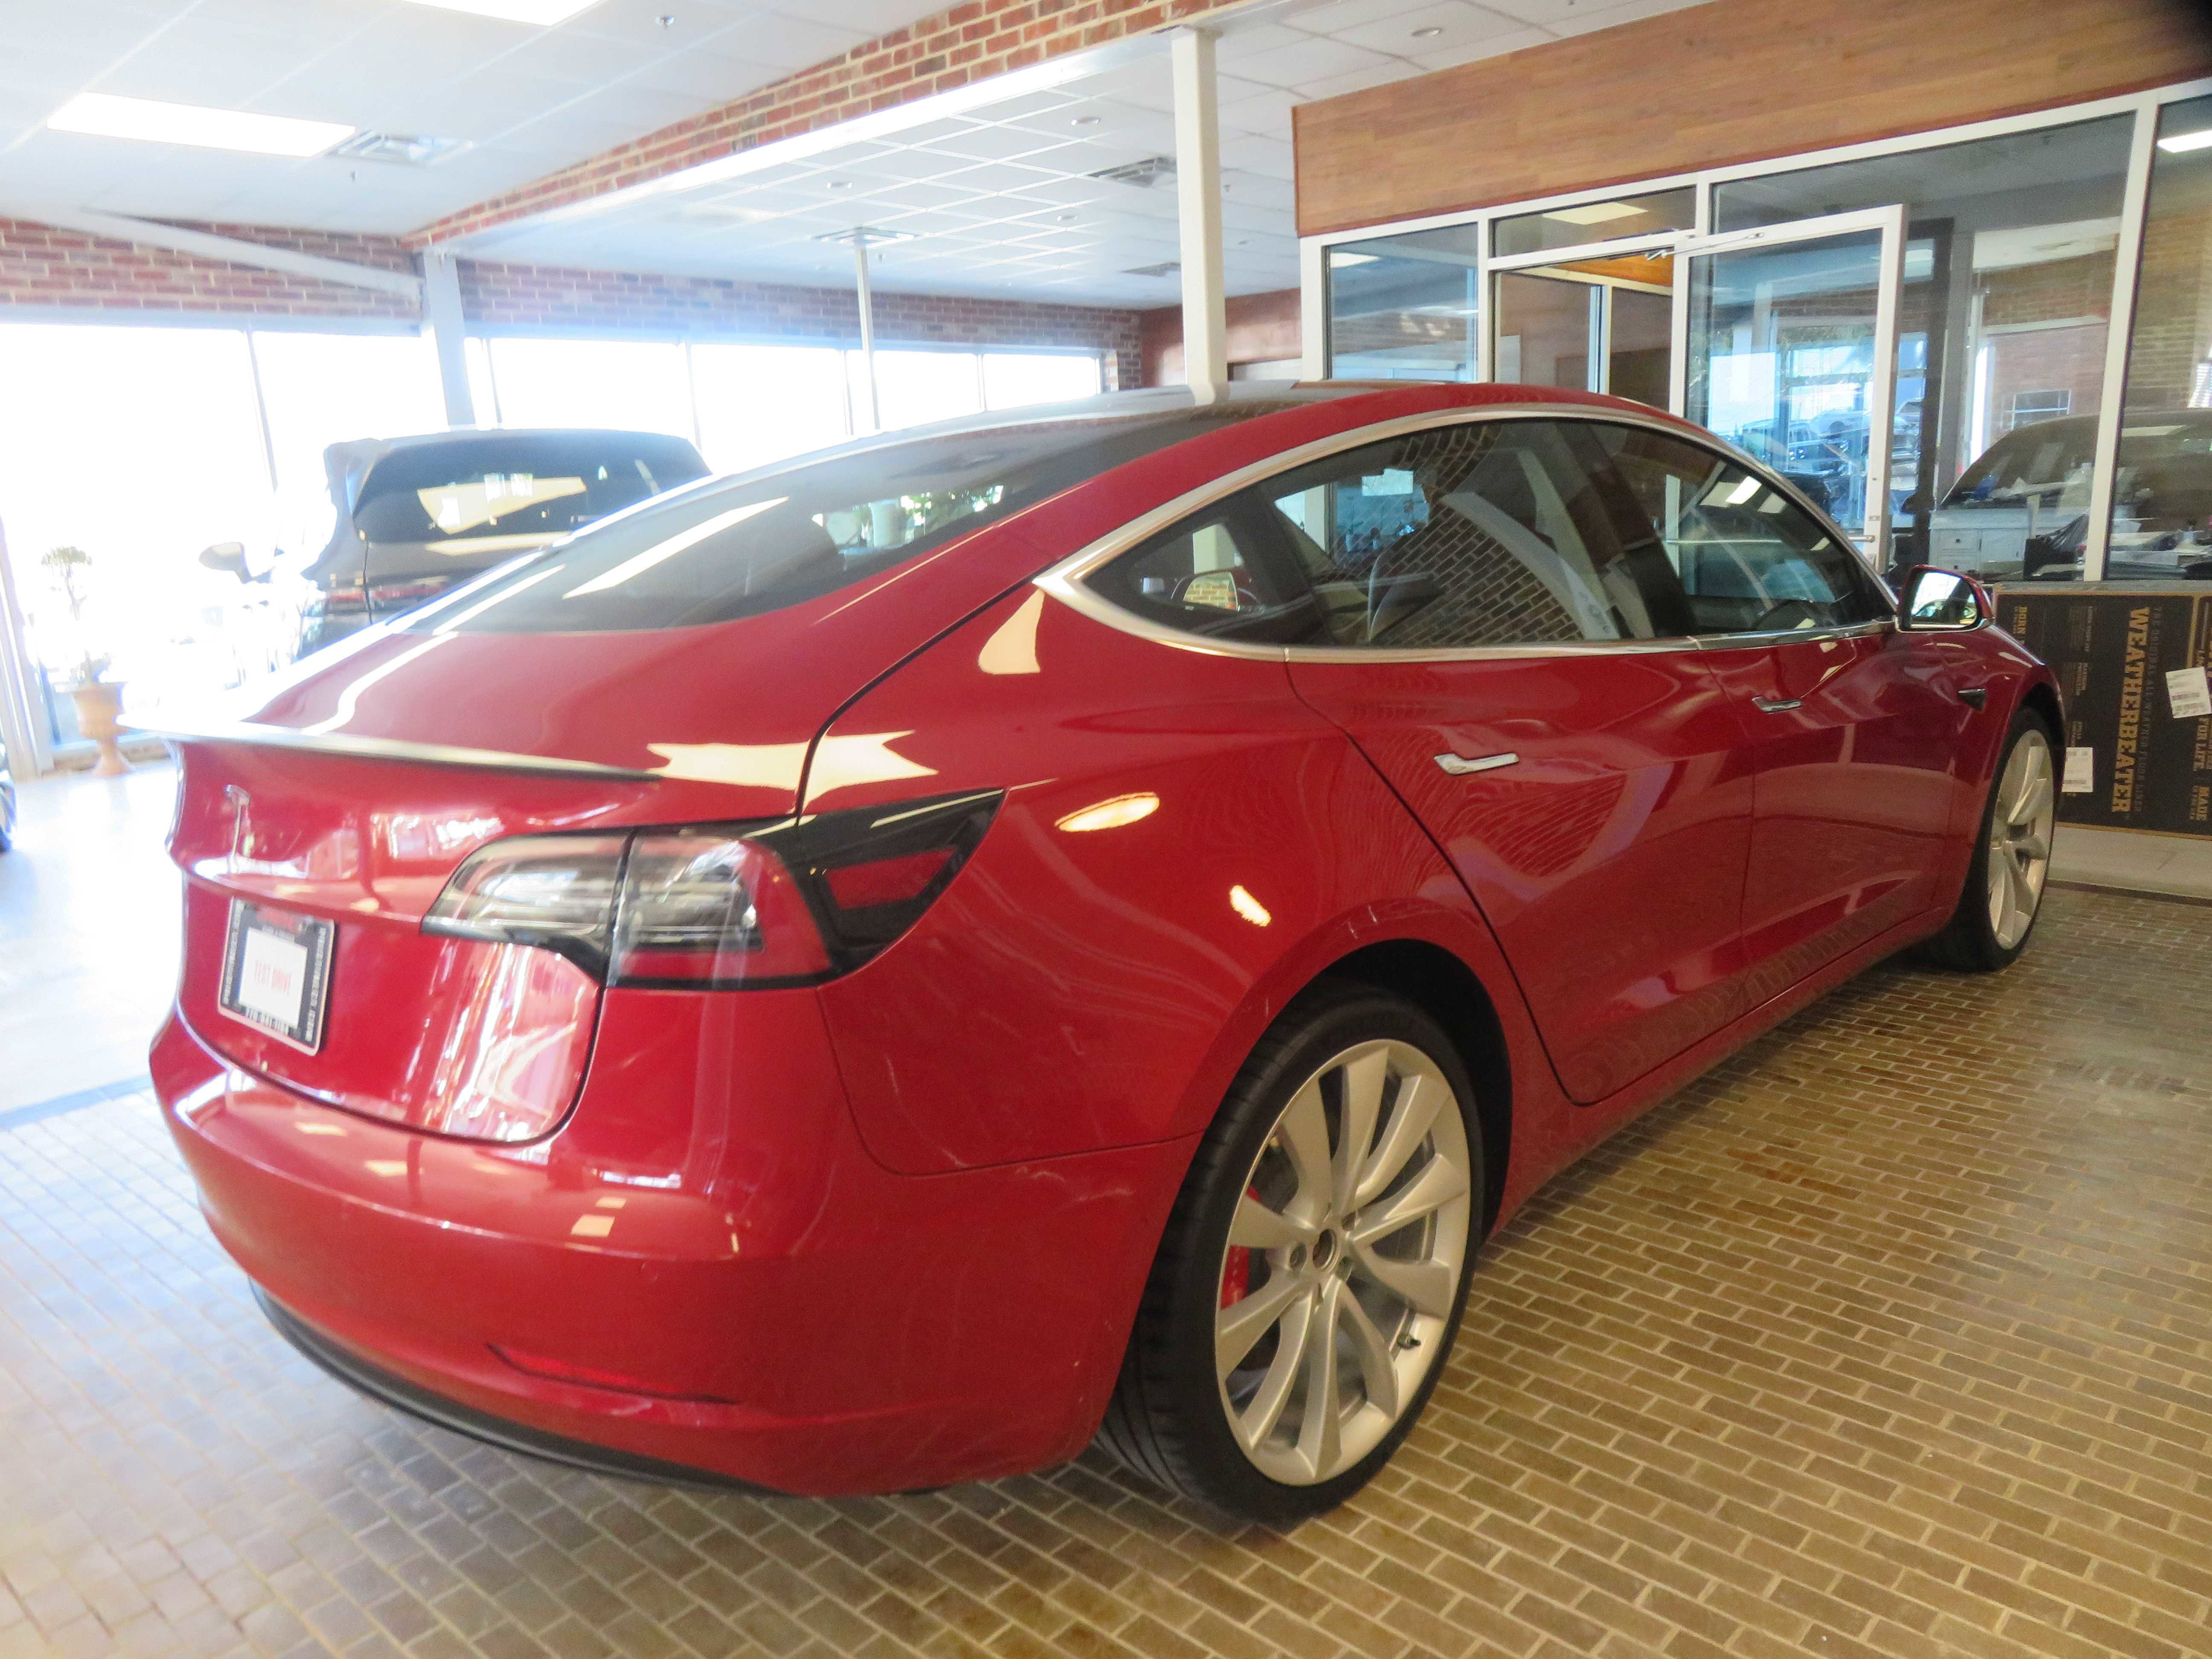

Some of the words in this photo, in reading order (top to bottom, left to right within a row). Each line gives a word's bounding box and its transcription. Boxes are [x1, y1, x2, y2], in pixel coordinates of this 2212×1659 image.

[2111, 607, 2150, 812] WEATHERBEATER
[2197, 718, 2209, 740] FOR
[2197, 786, 2210, 821] MADE
